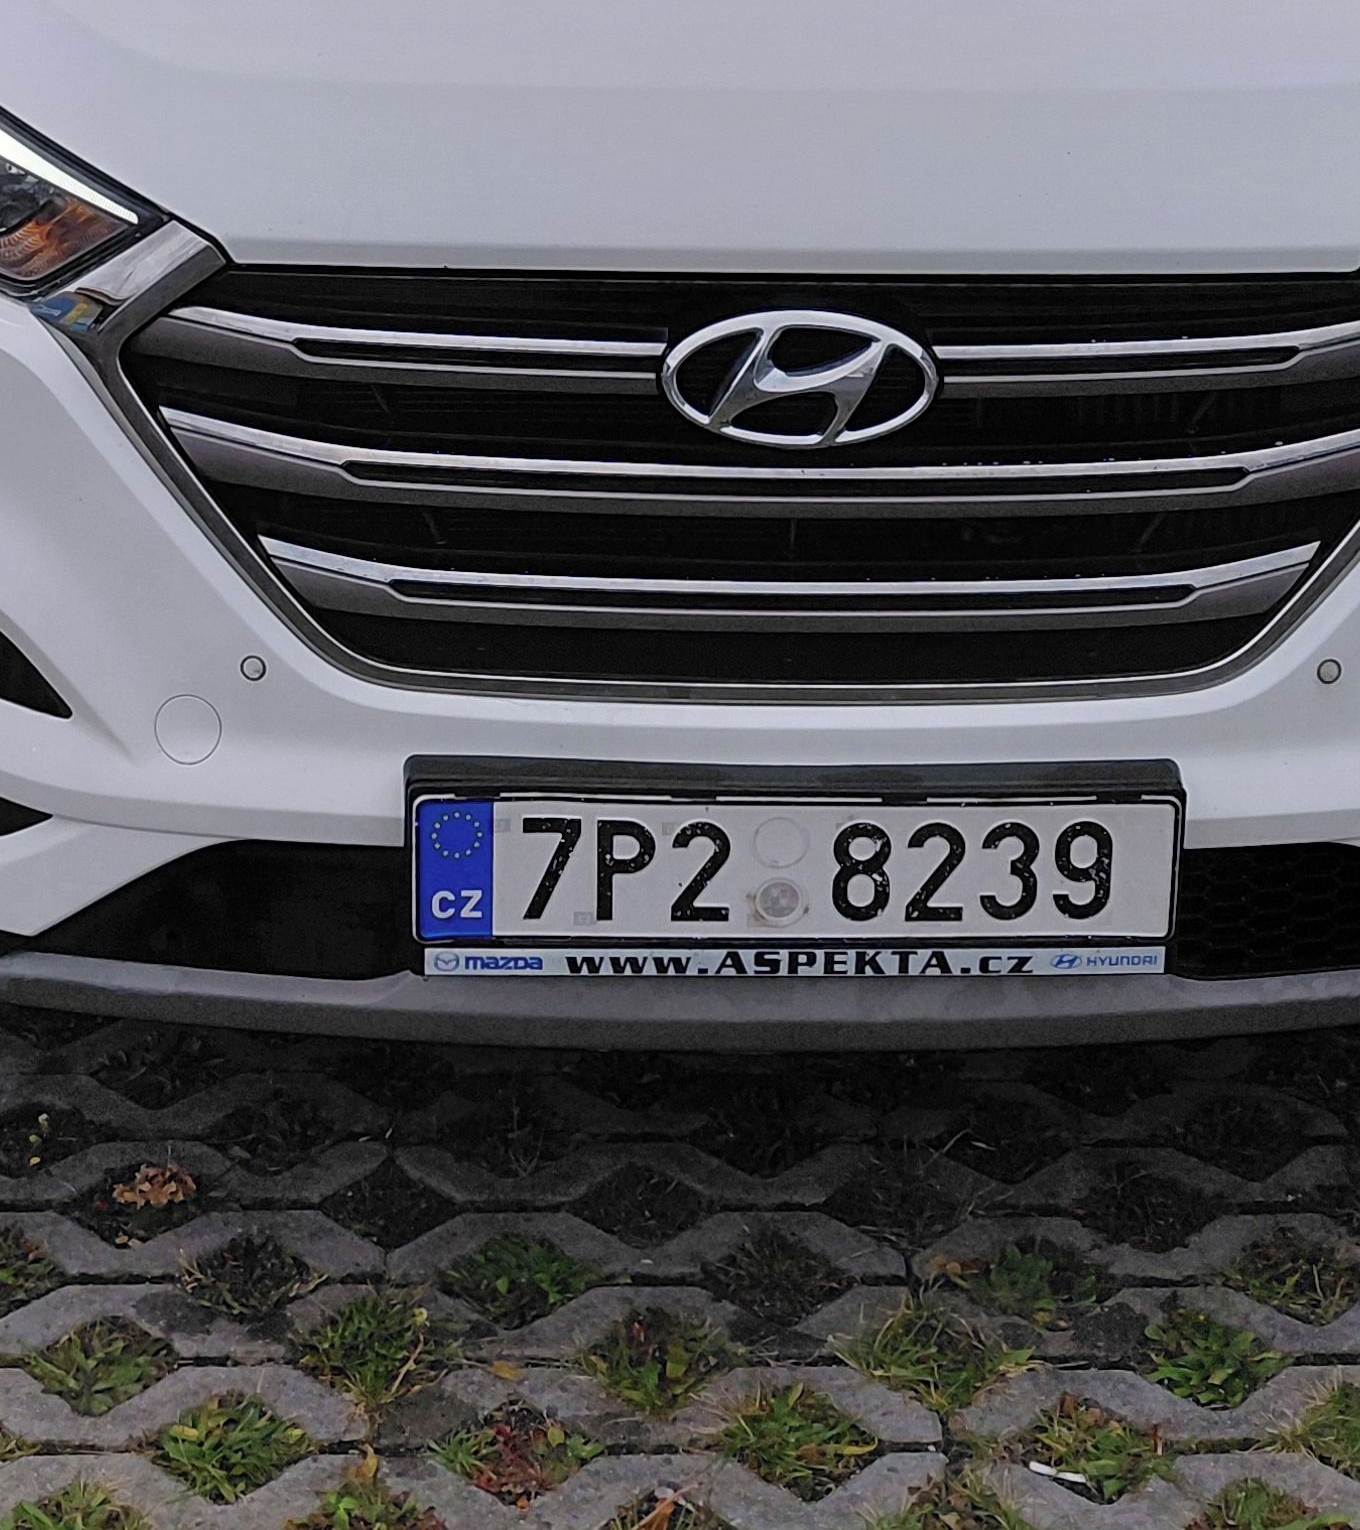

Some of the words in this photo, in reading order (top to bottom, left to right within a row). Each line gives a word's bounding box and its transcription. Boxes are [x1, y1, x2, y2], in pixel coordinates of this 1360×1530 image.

[522, 816, 732, 923] 7P2
[831, 820, 1114, 923] 8239
[430, 889, 484, 920] CZ
[1085, 954, 1159, 967] HYUNDAI
